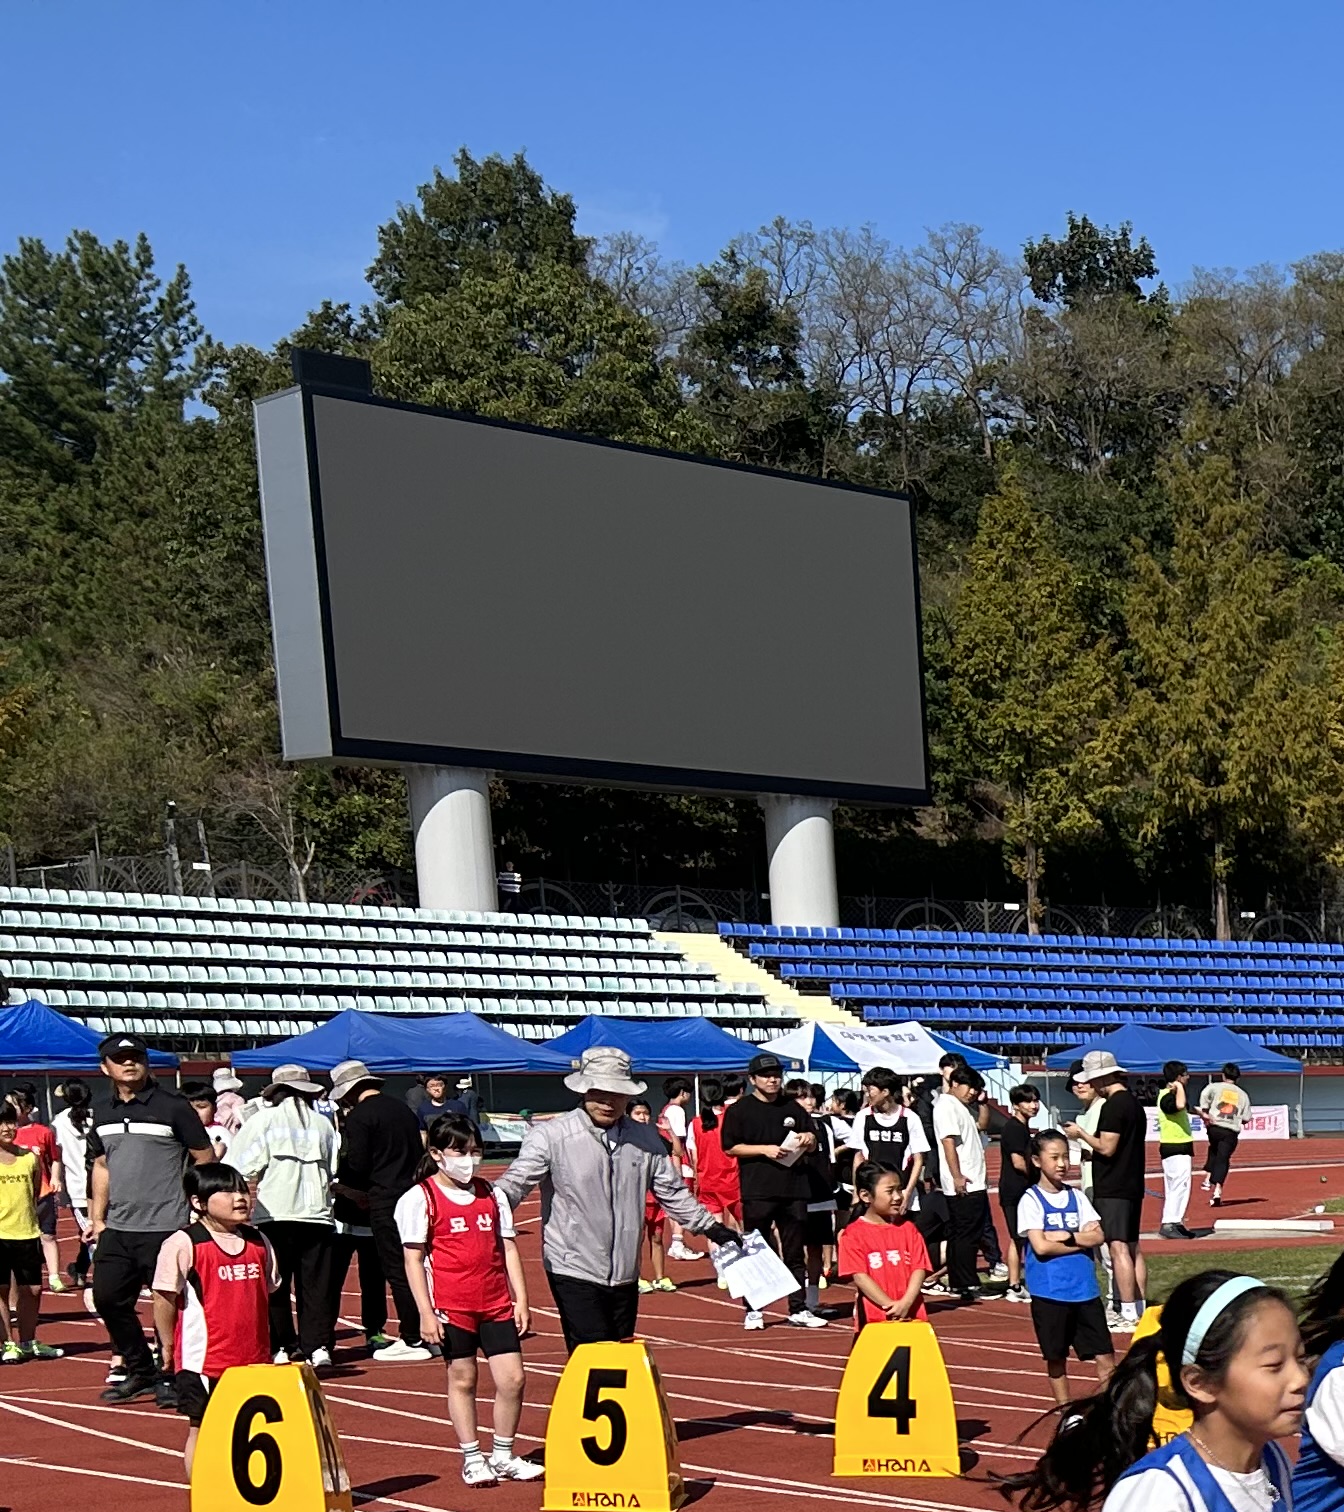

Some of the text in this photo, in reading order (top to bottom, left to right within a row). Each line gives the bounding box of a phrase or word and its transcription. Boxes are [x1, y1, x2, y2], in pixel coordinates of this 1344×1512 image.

[1046, 1212, 1079, 1229] 적중
[217, 1262, 261, 1282] 야로초
[580, 1368, 628, 1467] 5
[867, 1346, 917, 1435] 4
[231, 1394, 284, 1506] 6
